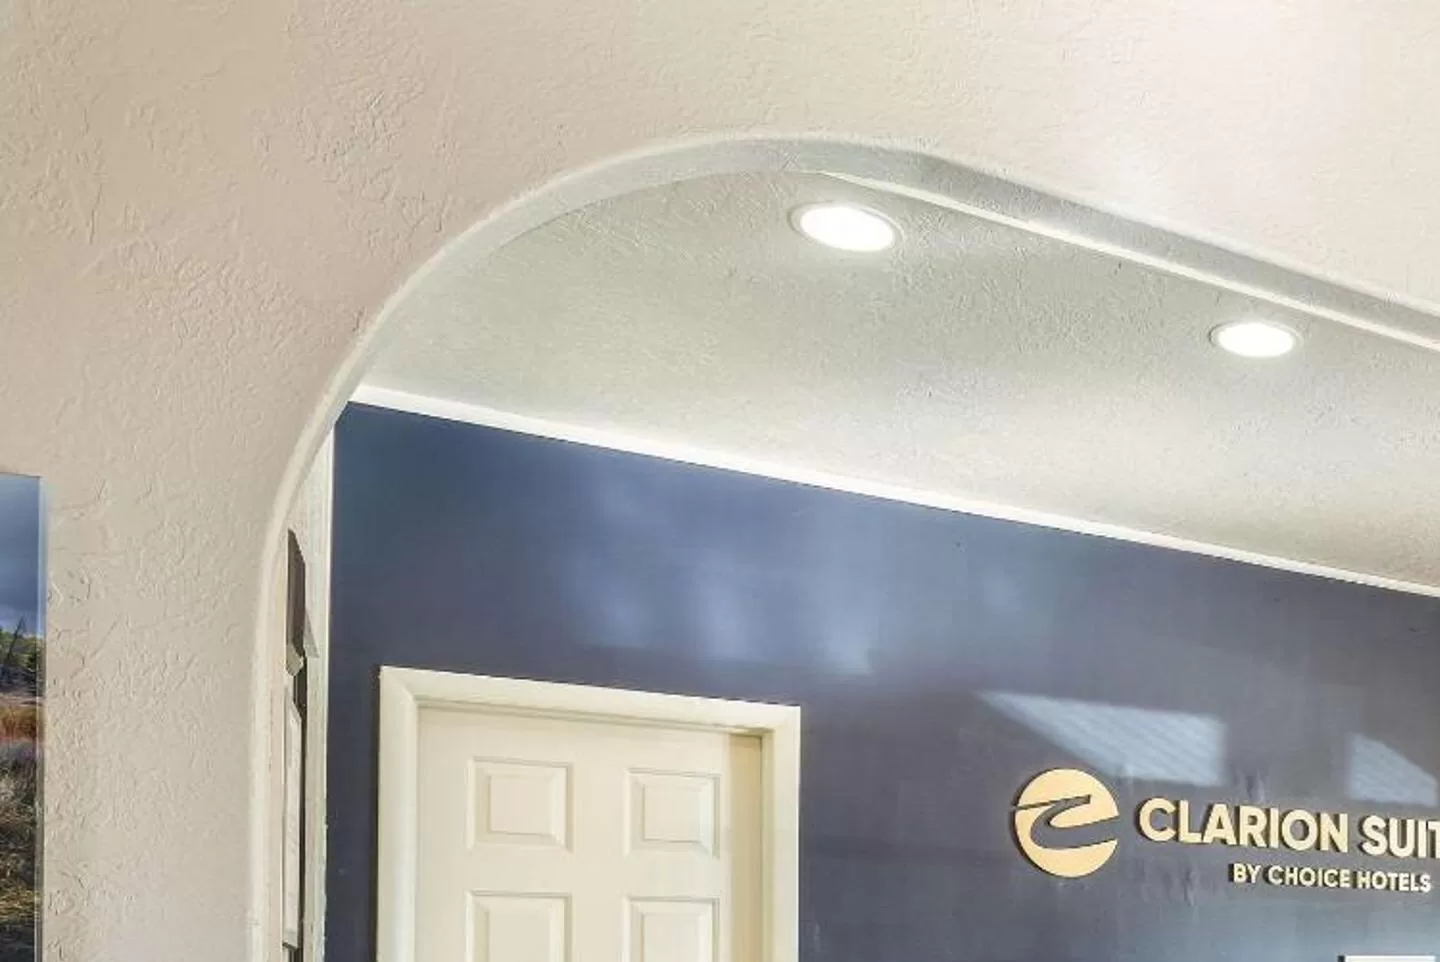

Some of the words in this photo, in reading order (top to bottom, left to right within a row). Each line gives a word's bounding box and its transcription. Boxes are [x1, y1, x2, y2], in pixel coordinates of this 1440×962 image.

[1138, 798, 1348, 853] CLARION
[1231, 864, 1262, 884] BY
[1265, 865, 1350, 888] CHOICE
[1355, 871, 1432, 893] HOTELS
